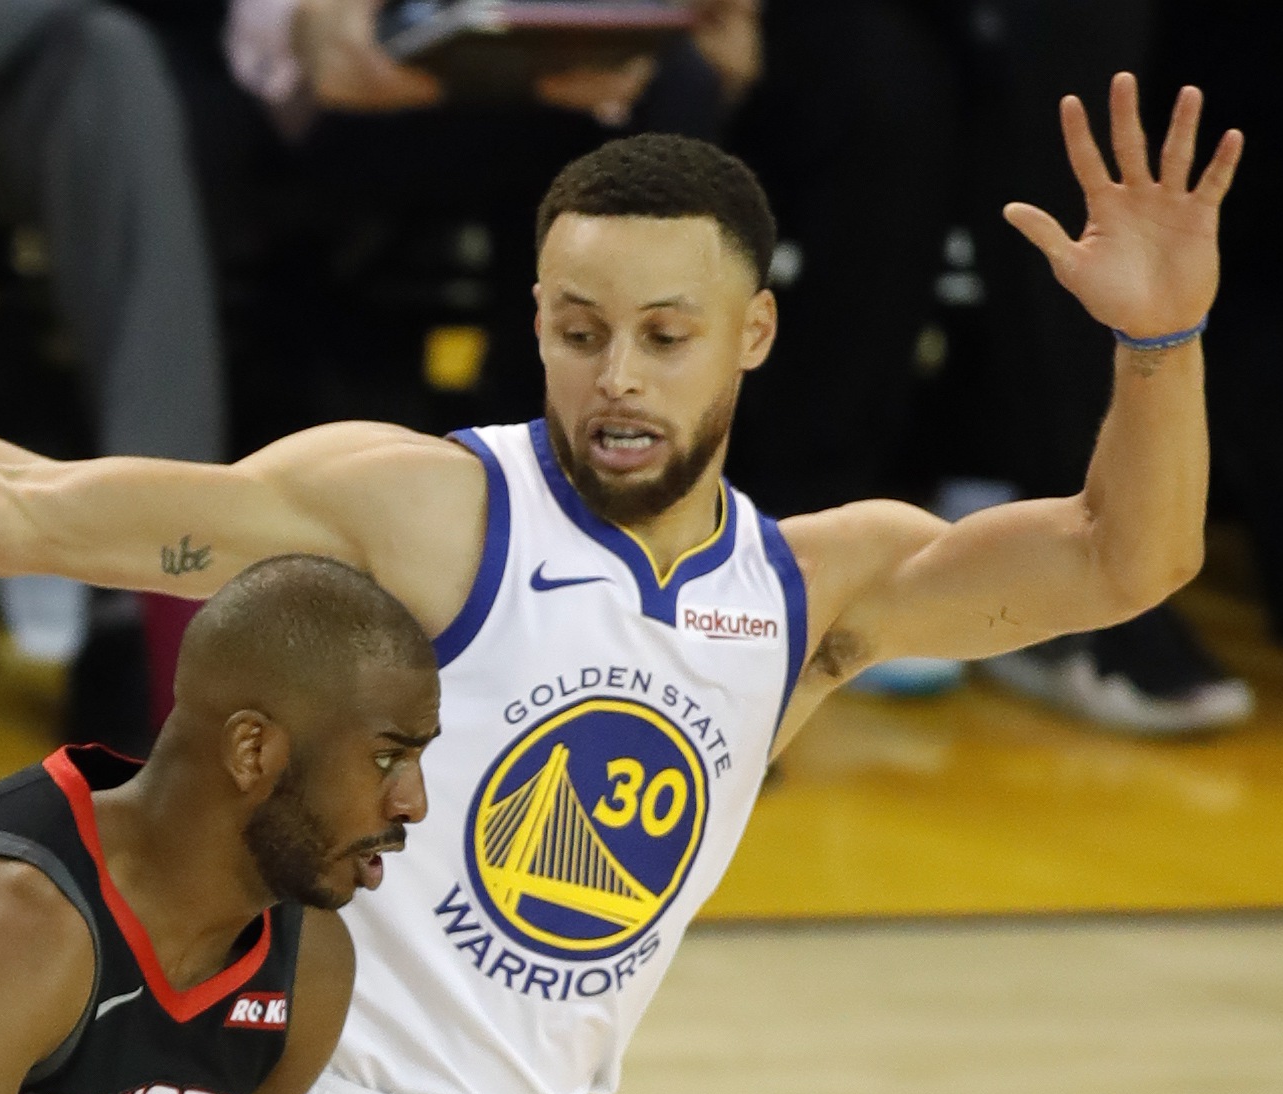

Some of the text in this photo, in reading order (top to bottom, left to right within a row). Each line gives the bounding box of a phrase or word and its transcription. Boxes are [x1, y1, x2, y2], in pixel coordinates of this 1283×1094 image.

[684, 608, 778, 639] Rakuten
[504, 666, 732, 779] GOLDEN STATE
[592, 757, 688, 838] 30
[434, 882, 661, 1002] WARRIORS
